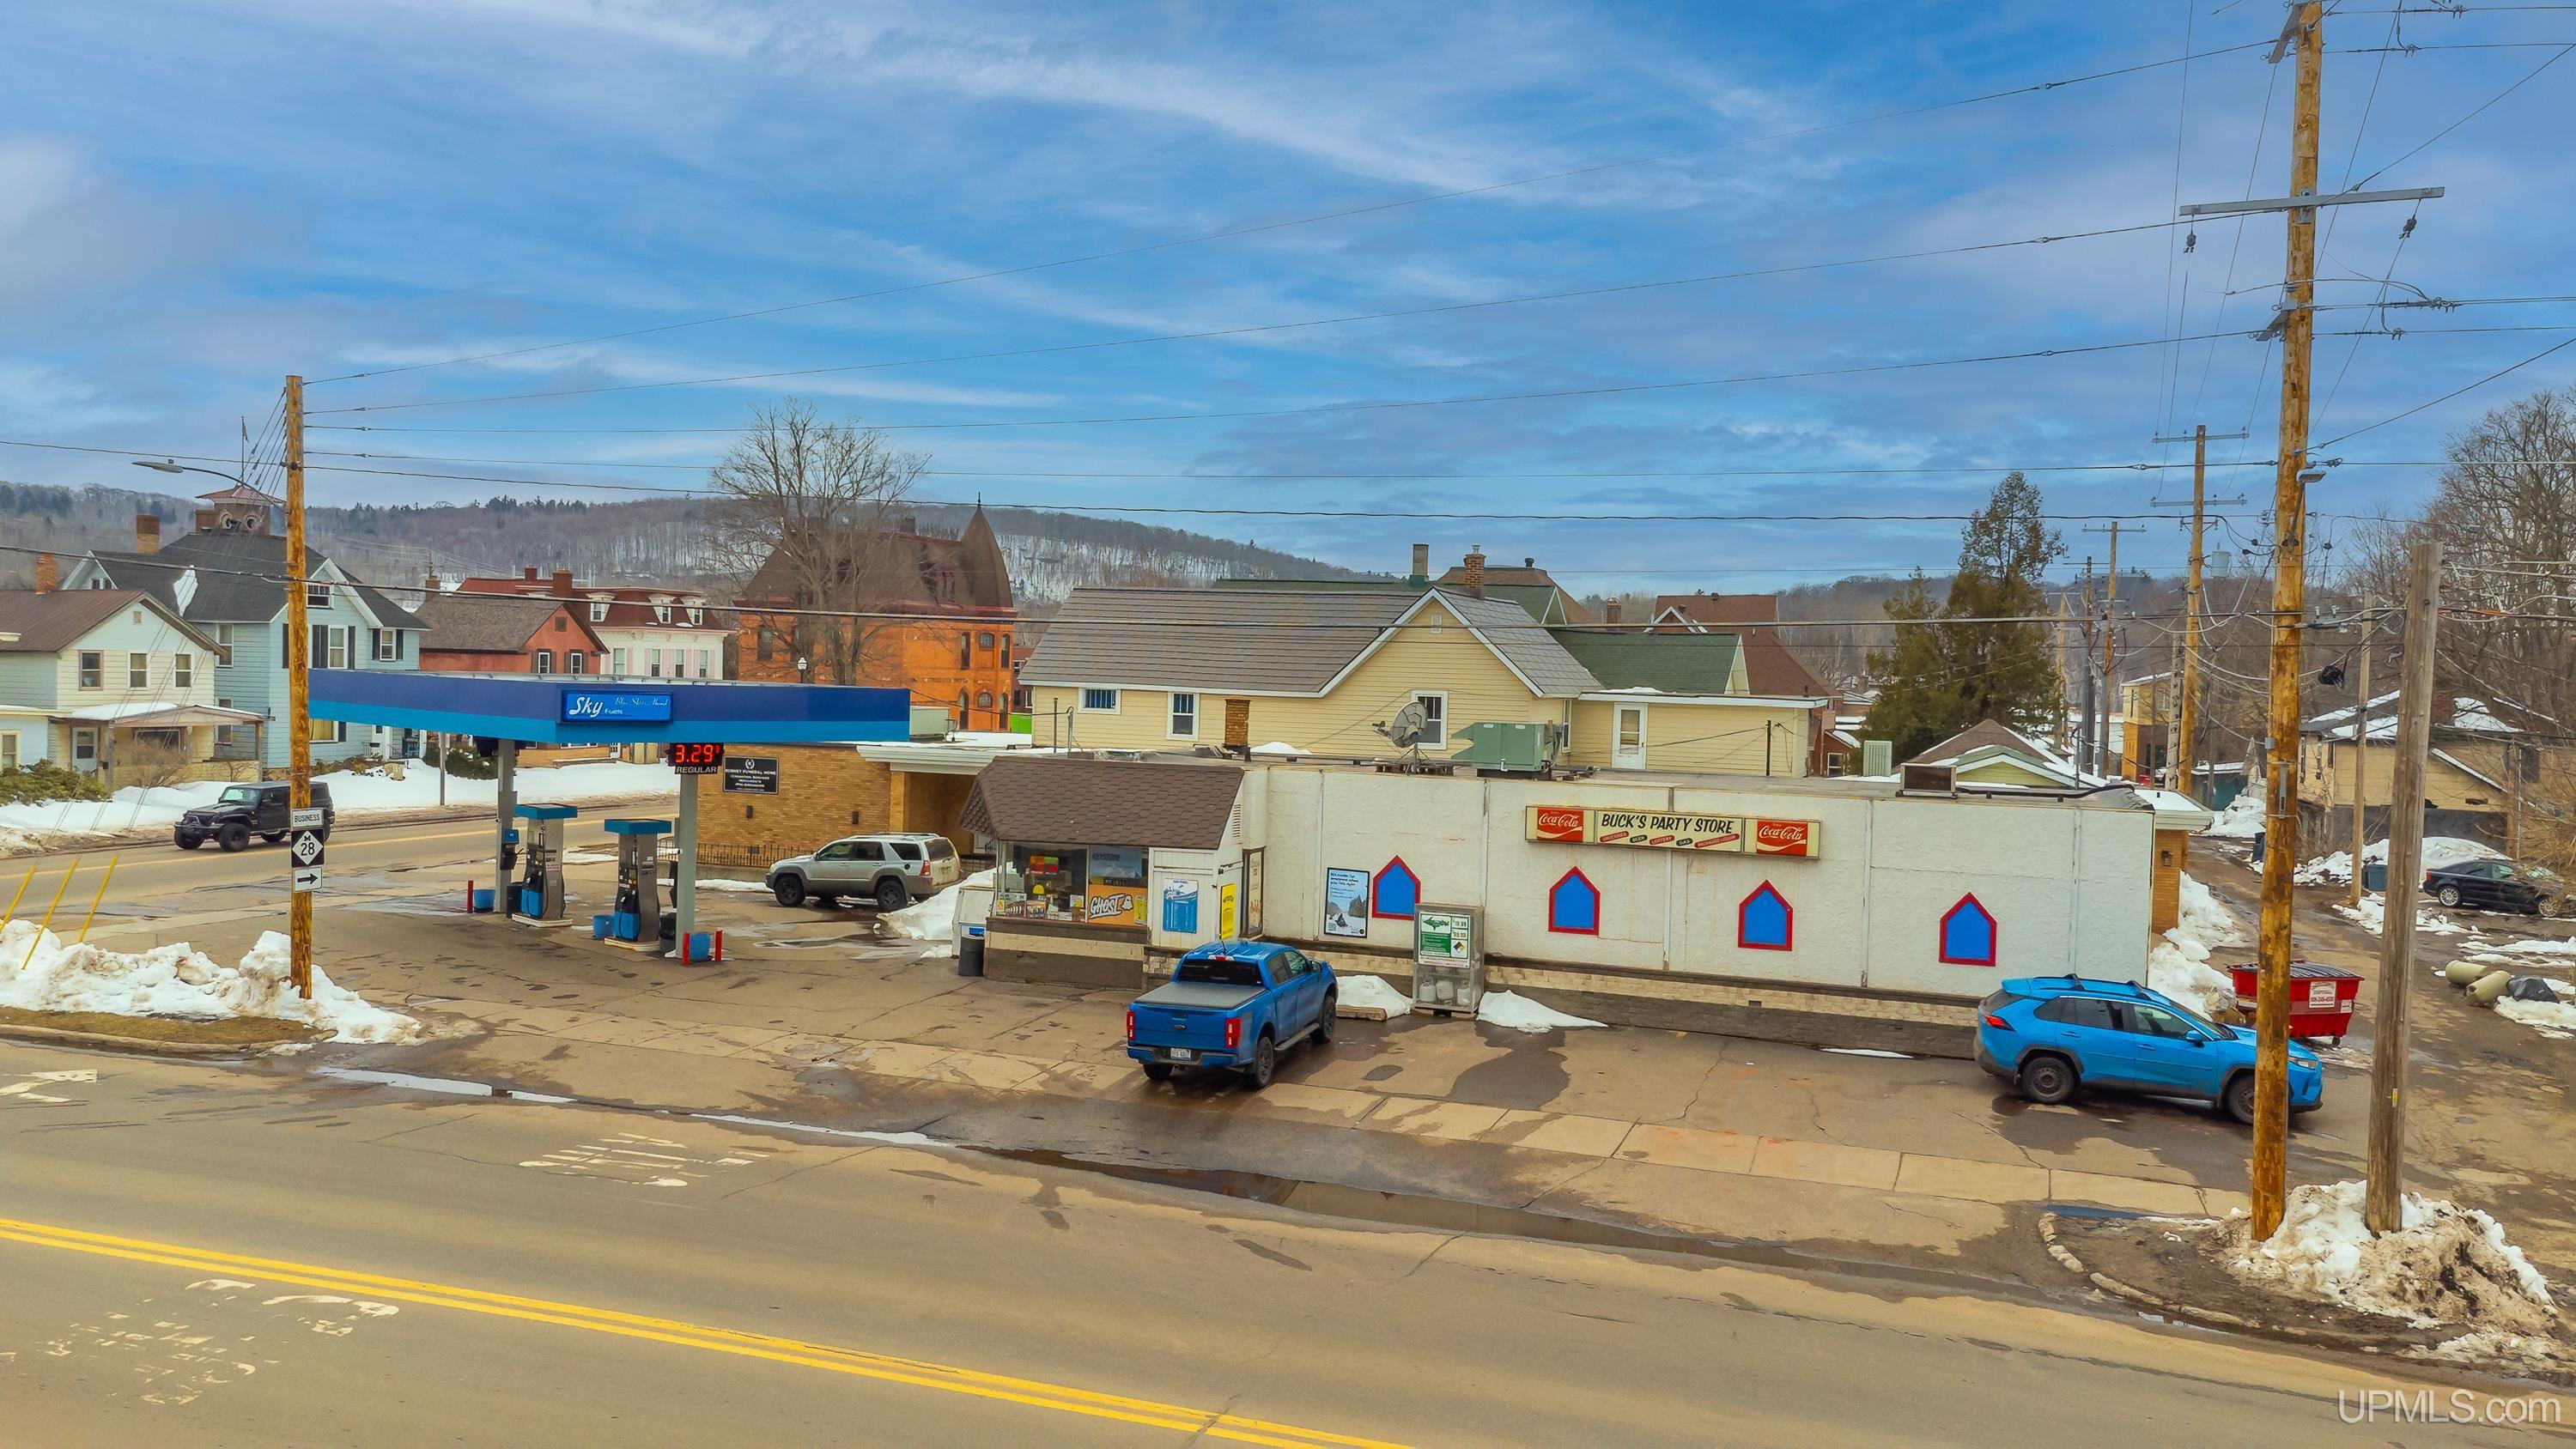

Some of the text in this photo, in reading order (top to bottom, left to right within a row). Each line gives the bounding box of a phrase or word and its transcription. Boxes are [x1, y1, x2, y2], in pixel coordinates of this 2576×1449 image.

[568, 696, 604, 718] Sky
[295, 814, 320, 822] BUSINESS
[1538, 813, 1579, 828] Coca-Cola
[1601, 814, 1734, 834] BUCK'S PARTY STORE
[1759, 825, 1805, 840] Coca-Cola
[1651, 836, 1673, 845] LOTTERY
[301, 842, 315, 856] 28
[1090, 894, 1125, 914] GHOST
